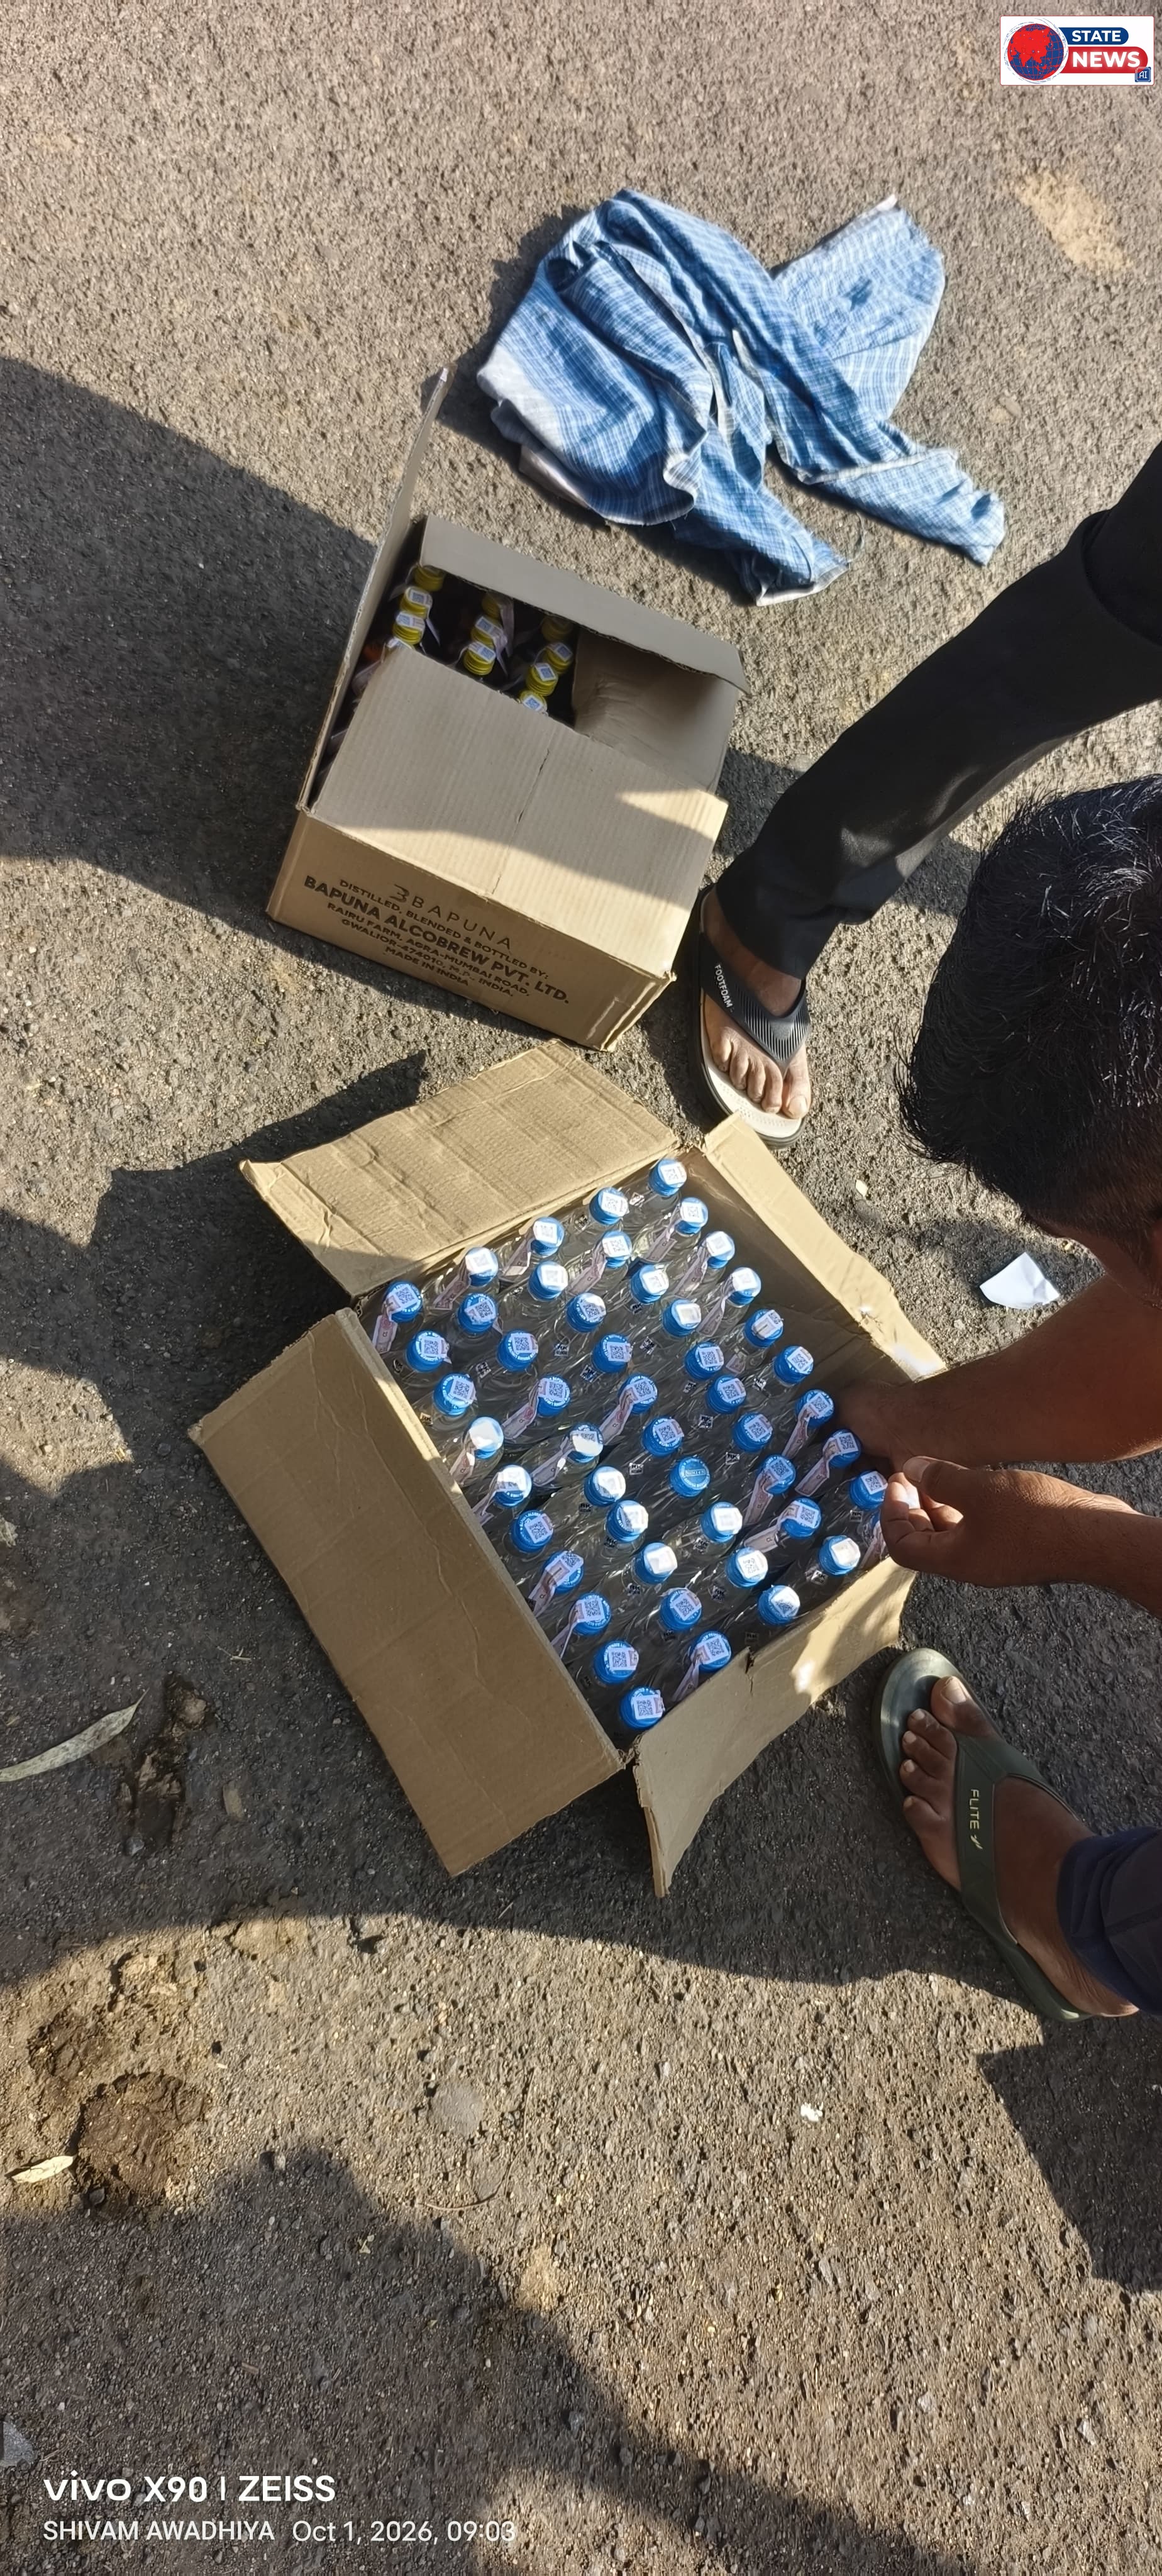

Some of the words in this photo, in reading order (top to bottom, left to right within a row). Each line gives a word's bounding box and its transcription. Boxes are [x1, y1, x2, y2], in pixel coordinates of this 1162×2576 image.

[304, 875, 380, 920] BAPUNA
[384, 914, 490, 965] ALCOBREW
[490, 960, 530, 987] PVT.
[534, 980, 569, 1004] LTD.
[327, 902, 365, 923] RAIRU
[406, 938, 492, 979] AGRA-MUMBAI
[406, 910, 462, 939] BLENDED
[473, 941, 528, 969] BOTTLED
[529, 966, 549, 980] BY:
[411, 896, 511, 950] BAPUNA
[385, 946, 419, 965] MADE
[421, 962, 435, 971] IN
[436, 969, 469, 986] INDIA
[714, 964, 733, 1008] FOOTFOAM
[970, 1789, 980, 1829] FLITE
